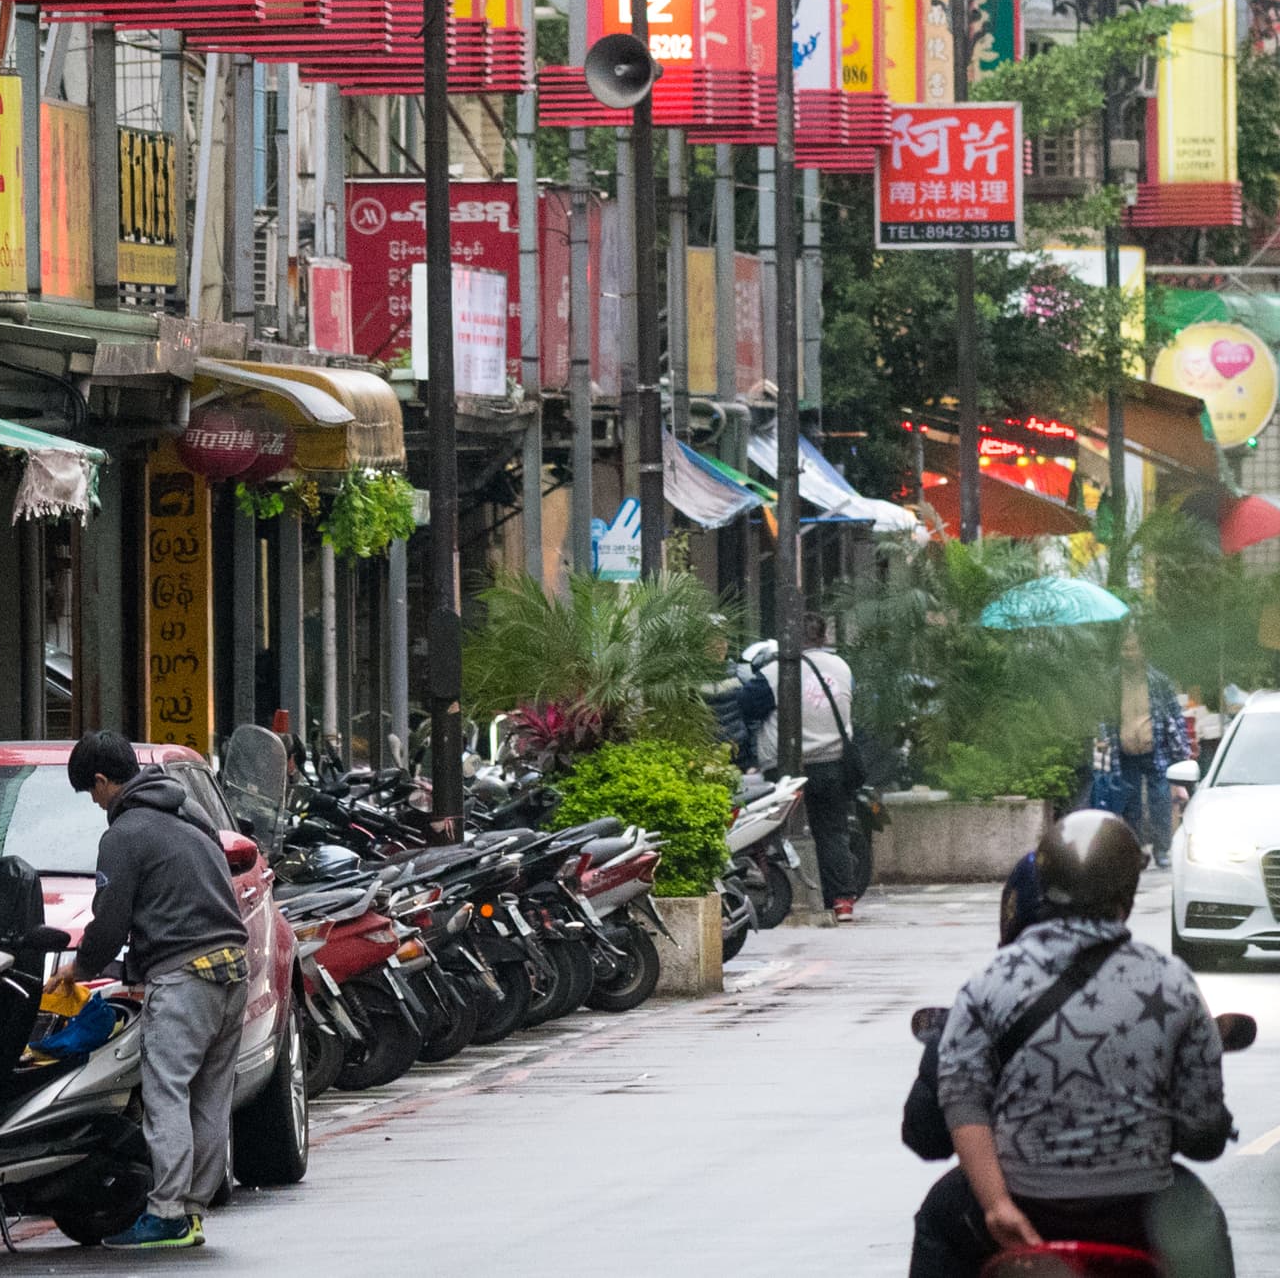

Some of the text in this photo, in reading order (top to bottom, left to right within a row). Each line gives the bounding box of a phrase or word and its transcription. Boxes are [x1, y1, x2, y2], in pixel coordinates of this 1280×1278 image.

[892, 113, 1009, 176] 阿芹
[889, 180, 1009, 205] 南洋料理
[887, 224, 1010, 240] TEL:8942-3515
